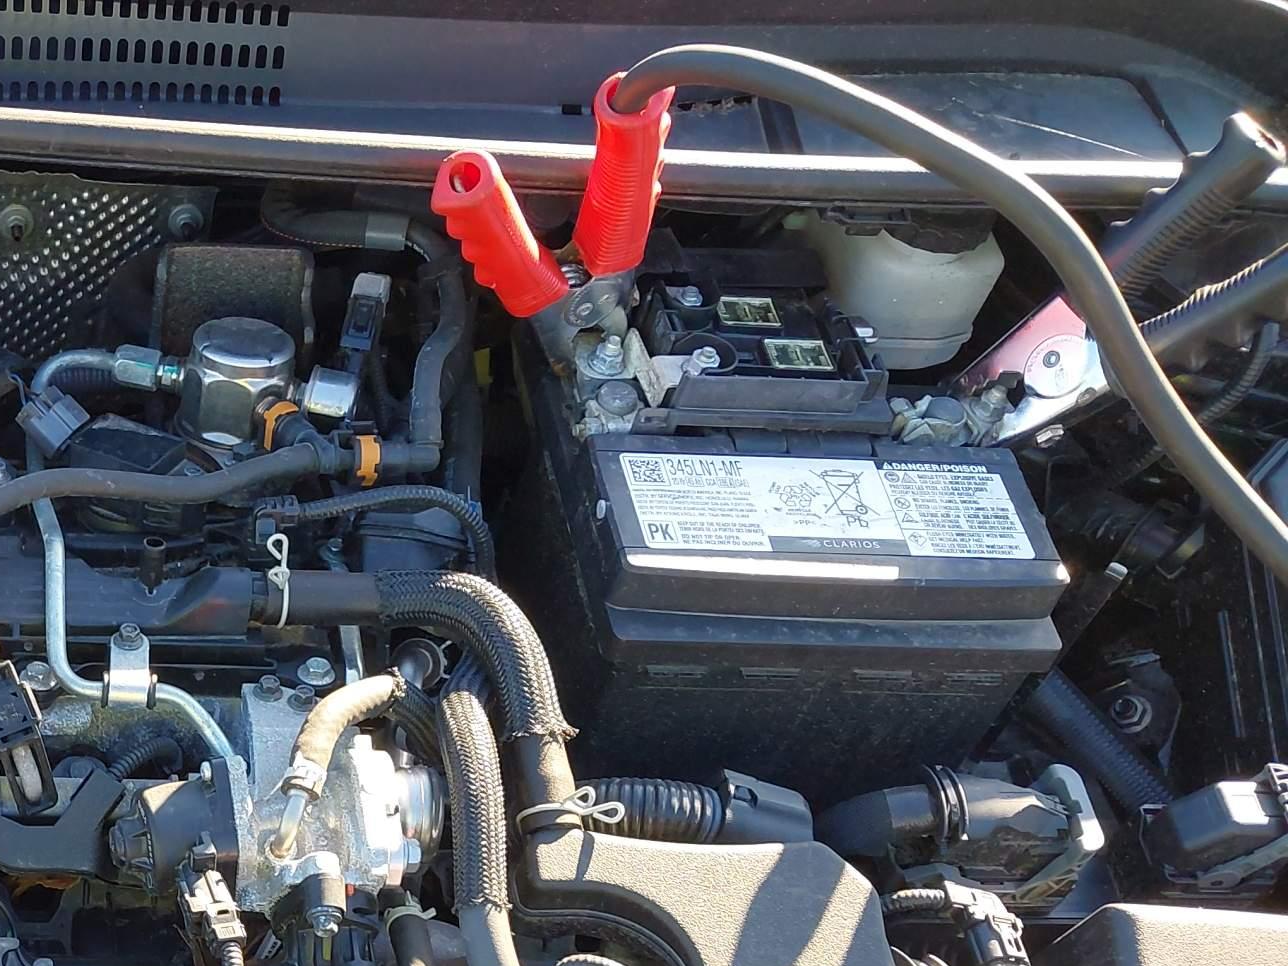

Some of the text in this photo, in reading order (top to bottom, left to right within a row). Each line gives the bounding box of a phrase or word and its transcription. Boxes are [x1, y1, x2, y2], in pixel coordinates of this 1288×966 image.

[666, 458, 743, 477] 345LN1-MF
[892, 462, 987, 473] DANGER/POISON
[648, 523, 674, 541] PK
[823, 539, 881, 549] CLARIOS
